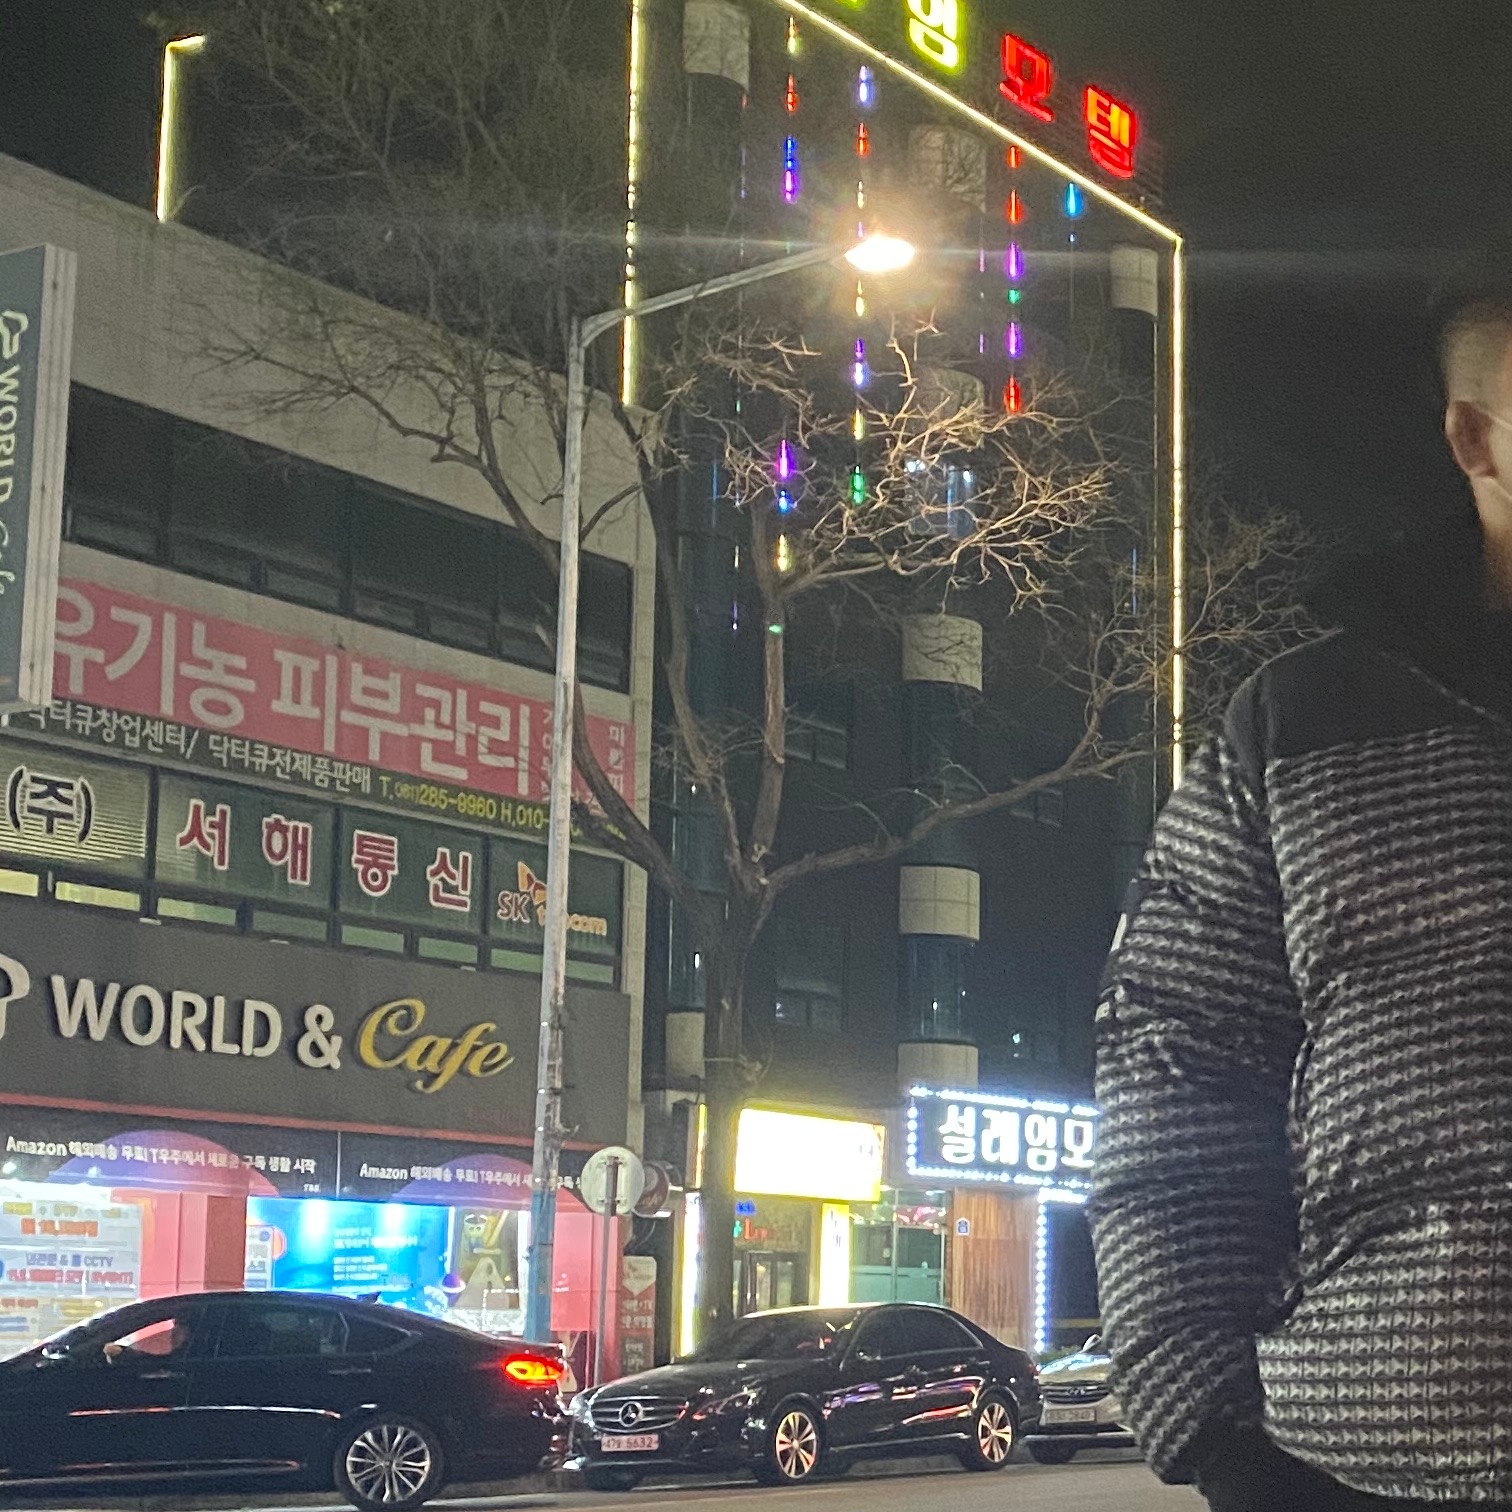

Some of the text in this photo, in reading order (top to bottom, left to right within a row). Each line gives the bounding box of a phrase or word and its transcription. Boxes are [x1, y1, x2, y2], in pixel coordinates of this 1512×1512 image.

[1000, 33, 1133, 179] 모텔
[271, 648, 530, 796] 피부관리
[6, 765, 473, 912] (주) 서해통신
[497, 890, 531, 923] SK
[50, 974, 514, 1094] WORLD & Cafe
[6, 1135, 68, 1157] Amazon
[359, 1163, 409, 1181] Amazon
